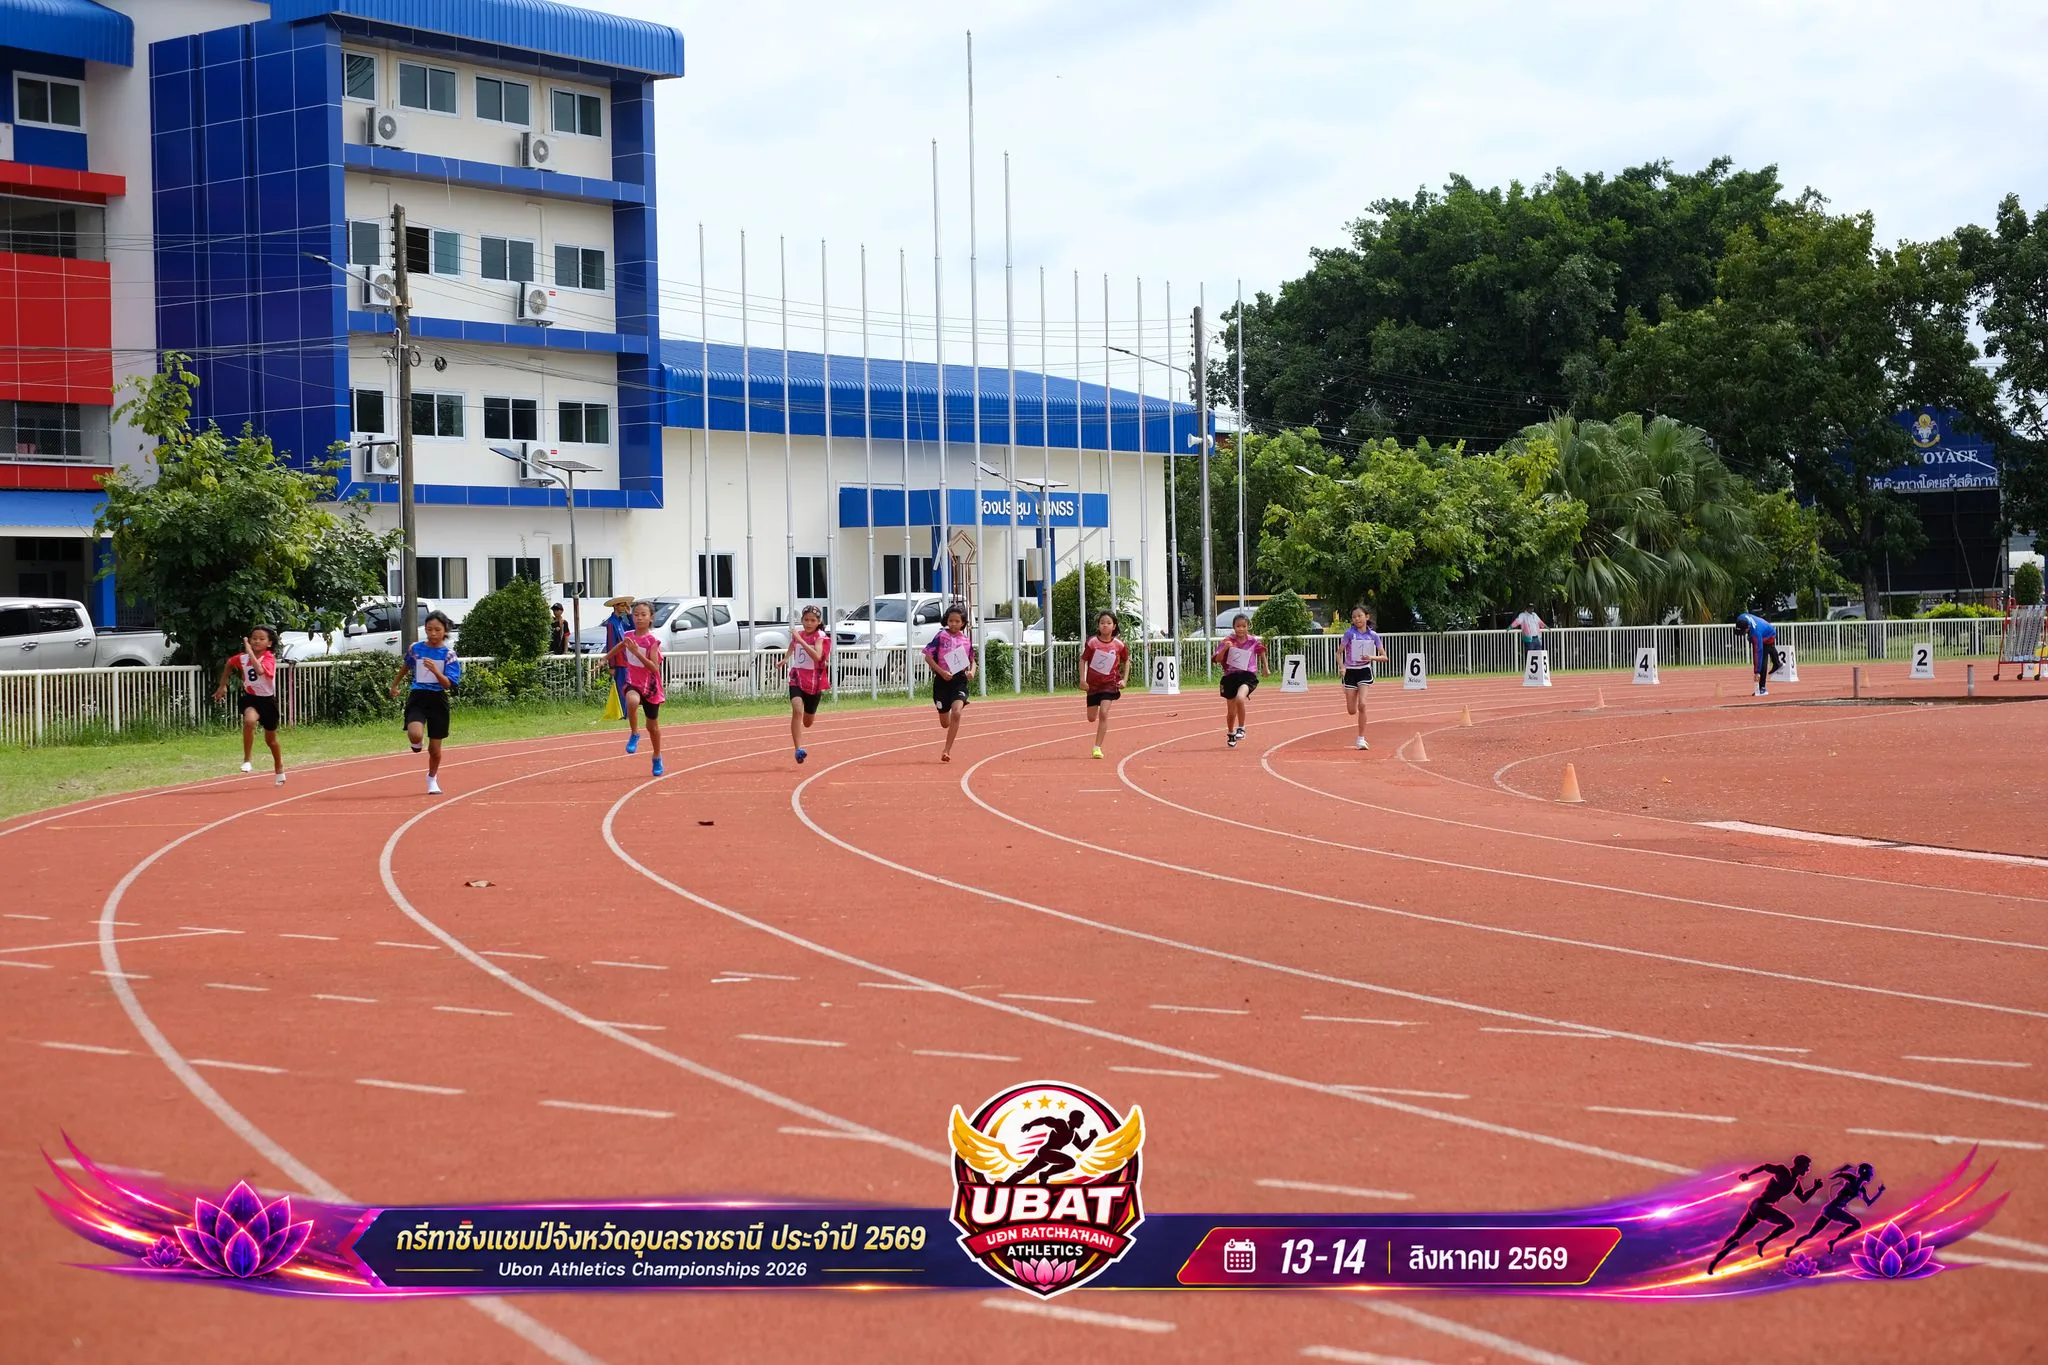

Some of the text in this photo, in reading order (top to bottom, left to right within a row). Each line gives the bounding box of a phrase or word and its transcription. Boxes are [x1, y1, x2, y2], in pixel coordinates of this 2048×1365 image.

[1921, 449, 1978, 464] OYAGE
[798, 647, 806, 664] 5
[1529, 655, 1539, 674] 5
[1543, 655, 1548, 674] 5
[1639, 653, 1649, 672] 4
[1790, 651, 1795, 669] 3
[1916, 649, 1928, 666] 2
[248, 669, 258, 681] 8
[1156, 661, 1165, 681] 8
[1169, 662, 1175, 680] 8
[1288, 660, 1301, 679] 7
[1409, 657, 1421, 677] 6
